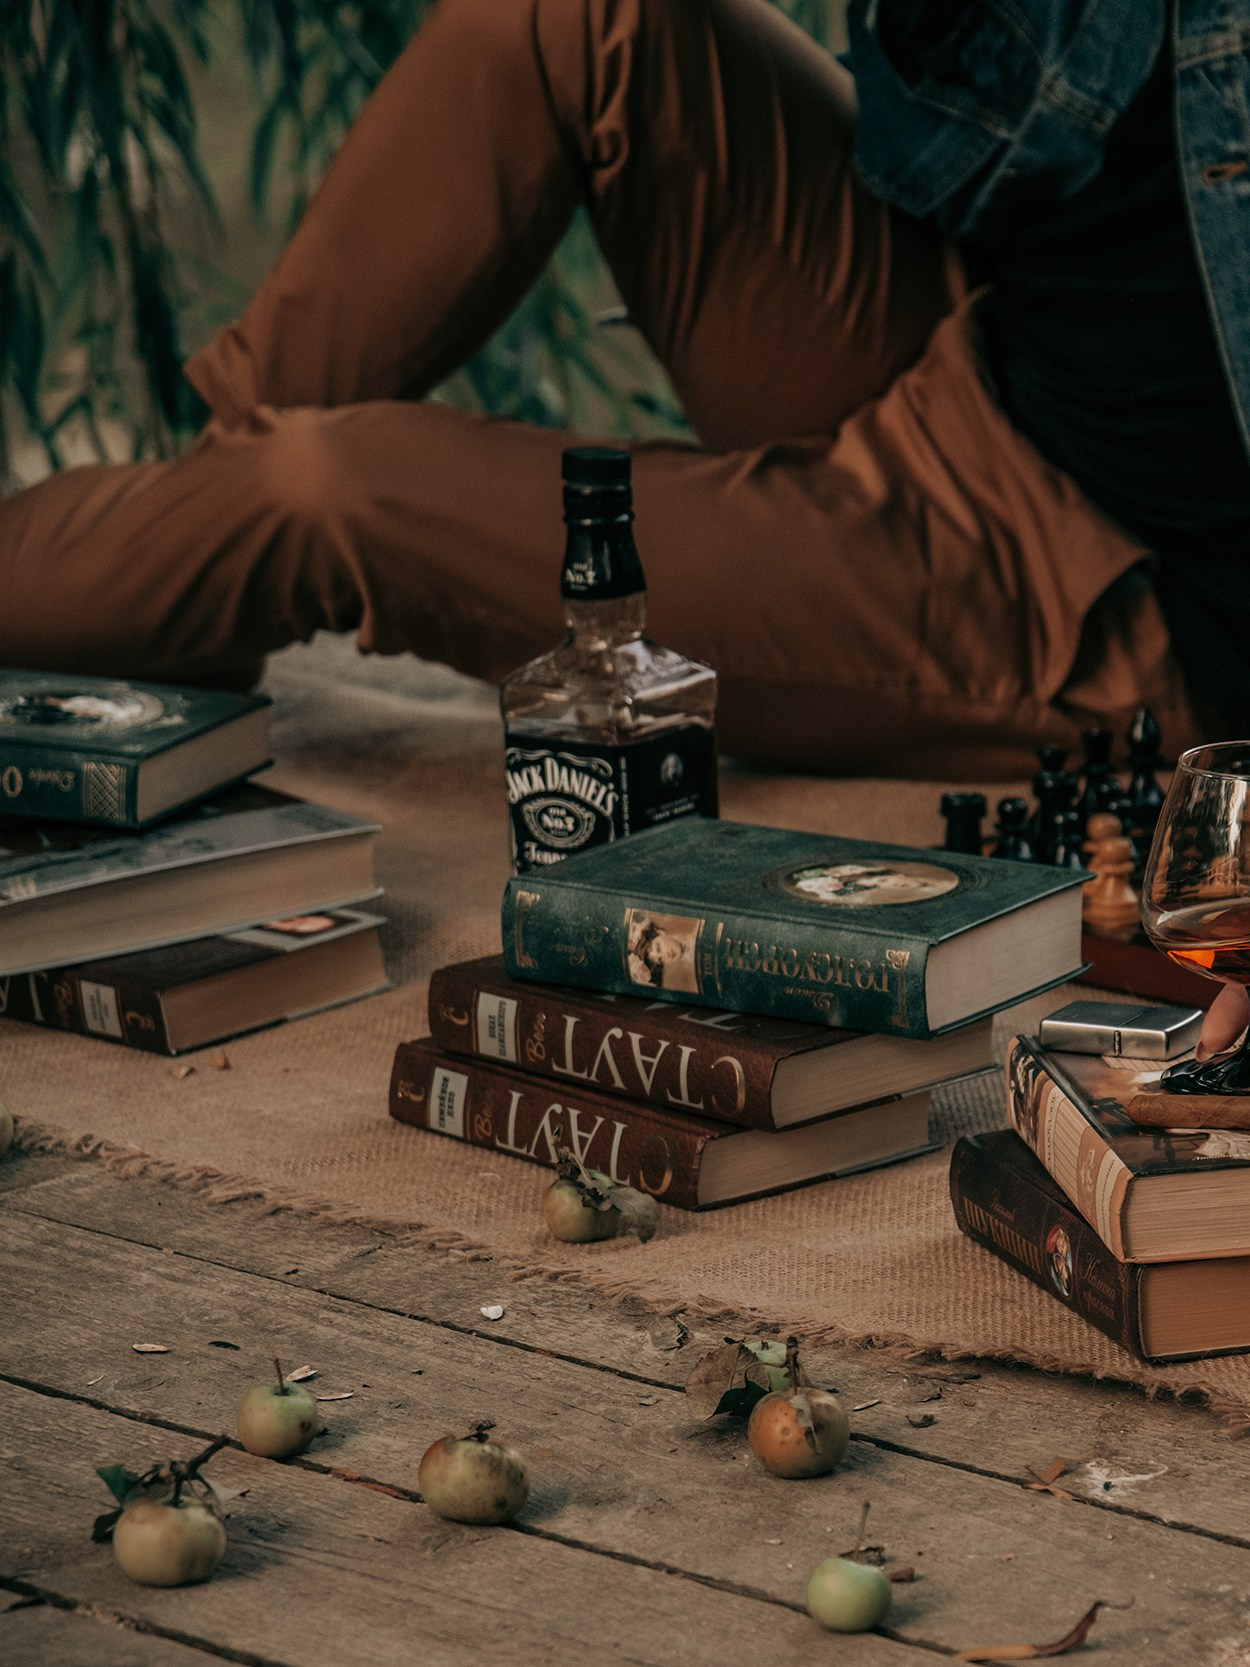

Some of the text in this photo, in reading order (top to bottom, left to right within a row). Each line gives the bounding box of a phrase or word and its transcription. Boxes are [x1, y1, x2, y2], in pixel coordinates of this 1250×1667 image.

[506, 763, 545, 804] JACK
[544, 757, 619, 817] DANIEL'S
[726, 938, 889, 993] ГОЛСУОРСИ
[551, 1014, 745, 1115] СТАУТ
[496, 1089, 673, 1195] СТАУТ
